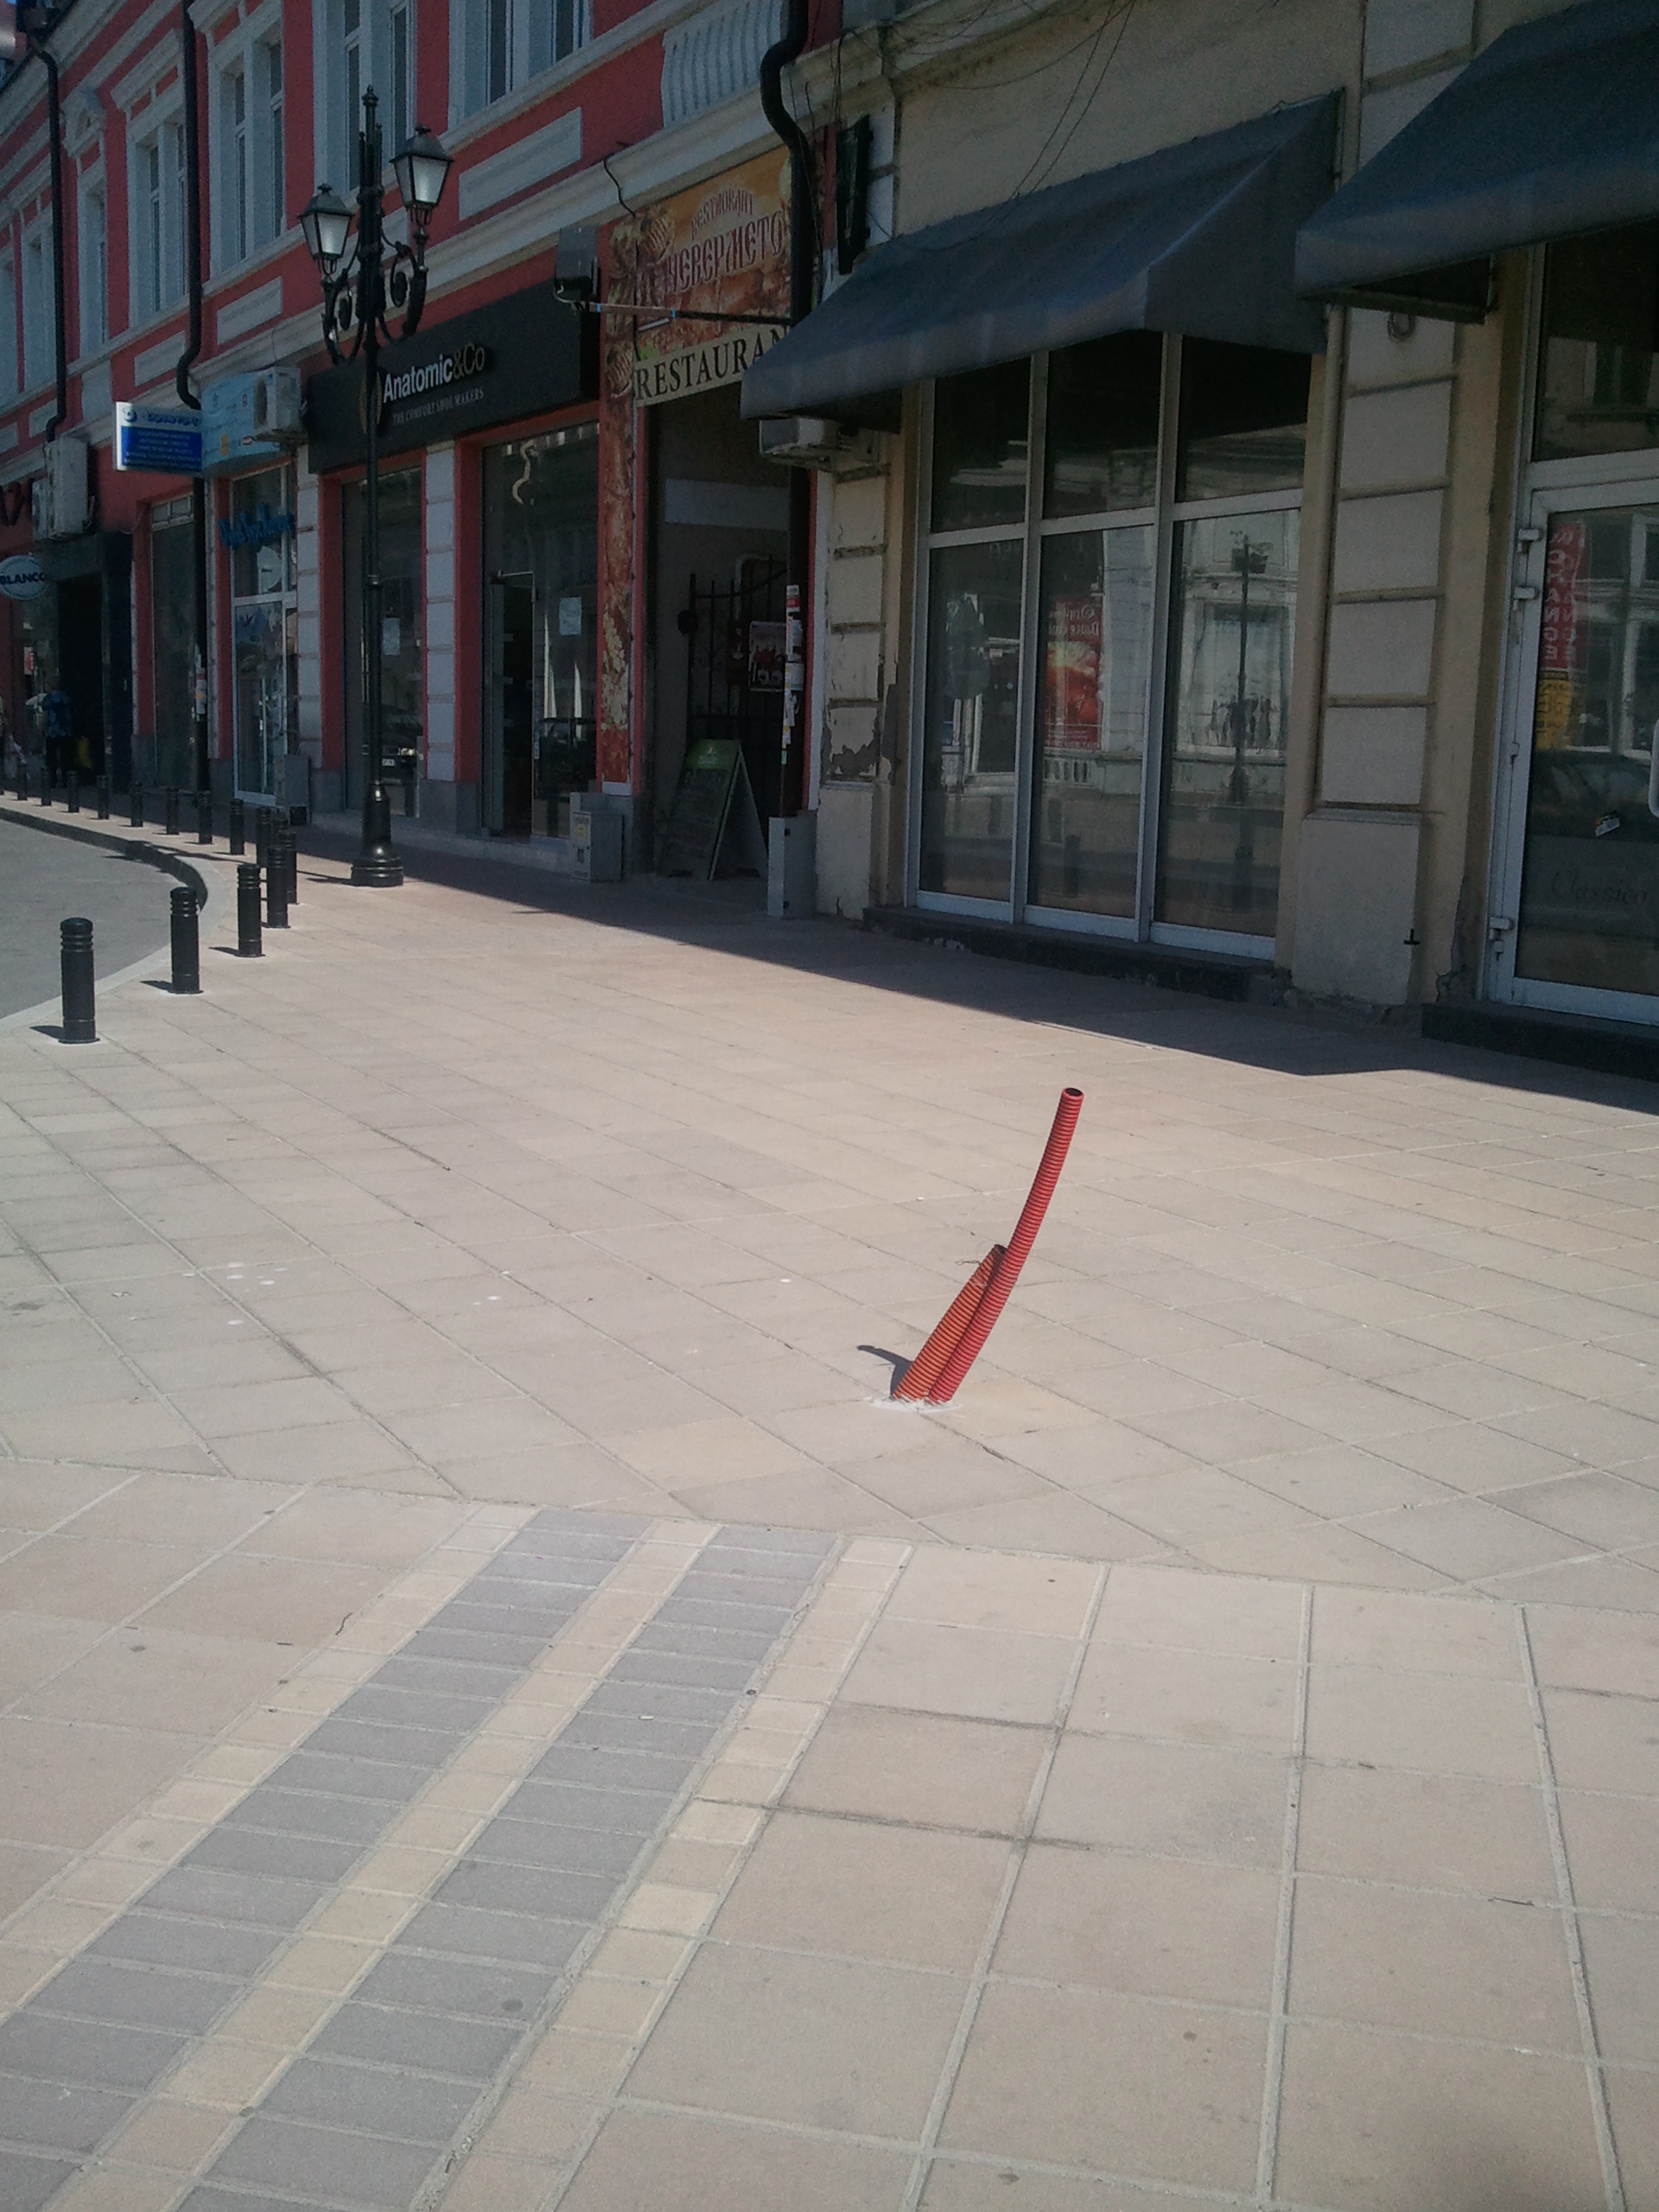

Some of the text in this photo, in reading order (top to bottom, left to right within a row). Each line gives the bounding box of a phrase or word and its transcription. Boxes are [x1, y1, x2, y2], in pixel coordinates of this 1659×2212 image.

[383, 342, 486, 404] Anatomic&Co
[635, 325, 790, 401] RESTAURAN
[454, 388, 484, 406] MAKERS
